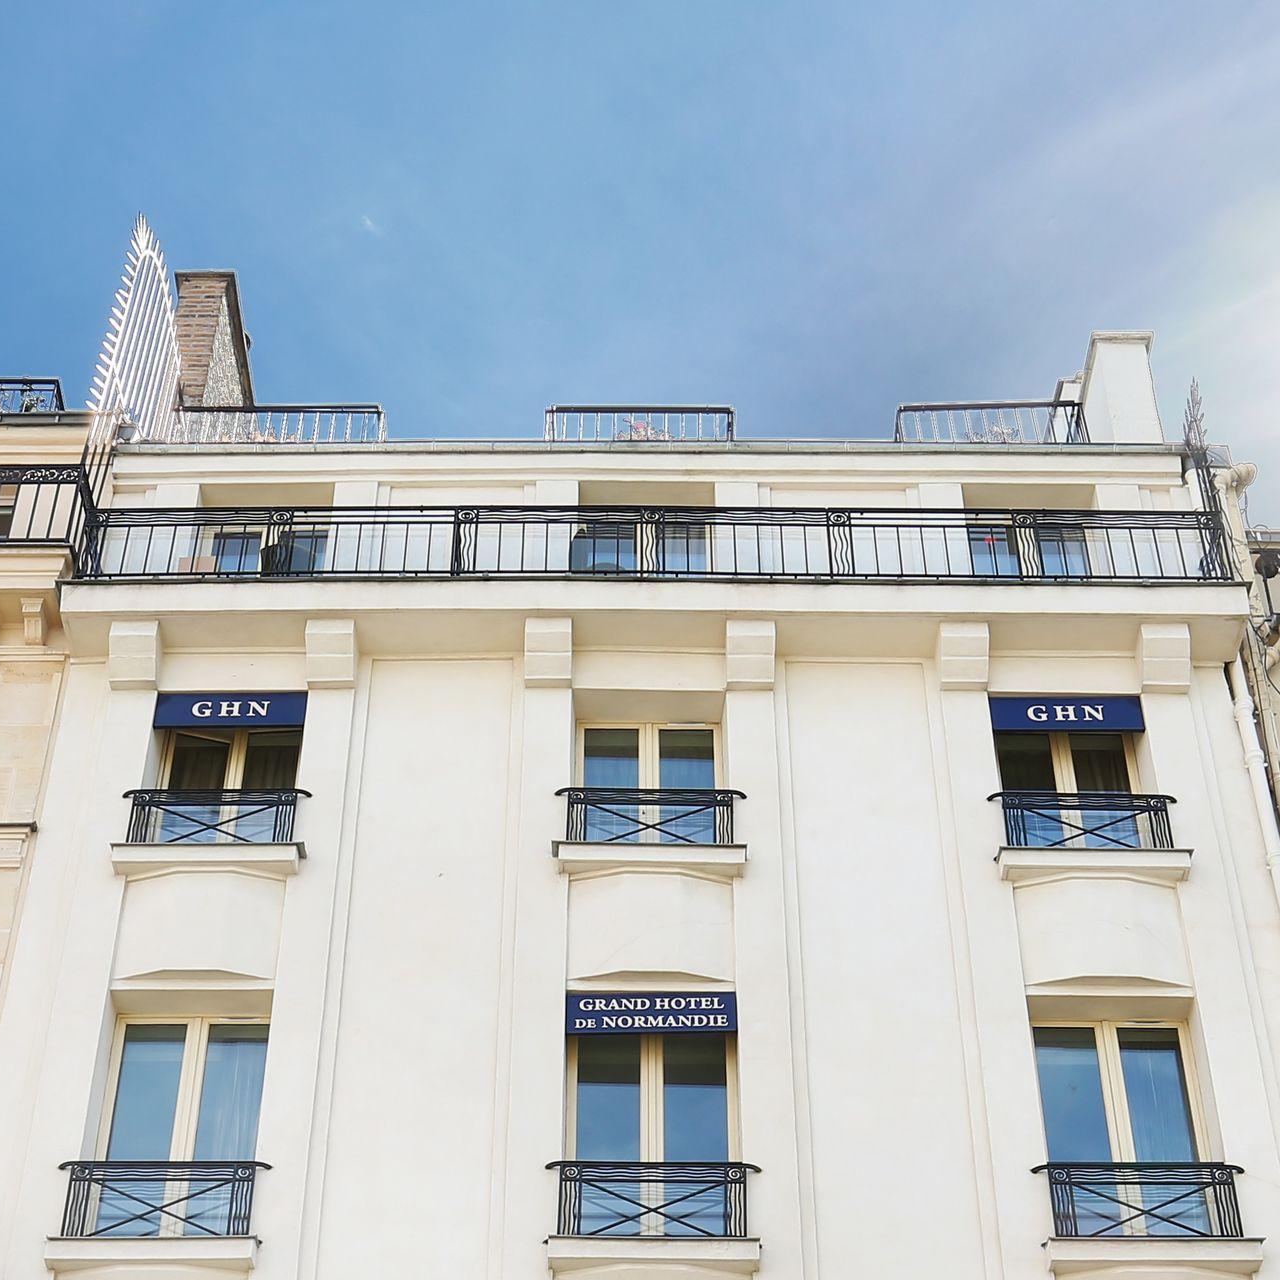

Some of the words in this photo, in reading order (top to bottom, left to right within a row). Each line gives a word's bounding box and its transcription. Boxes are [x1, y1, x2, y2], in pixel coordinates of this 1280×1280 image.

[191, 701, 271, 718] GHN
[1027, 705, 1105, 721] GHN
[579, 998, 651, 1011] GRAND
[654, 997, 725, 1010] HOTEL
[574, 1018, 597, 1029] DE
[601, 1014, 729, 1028] NORMANDIE
